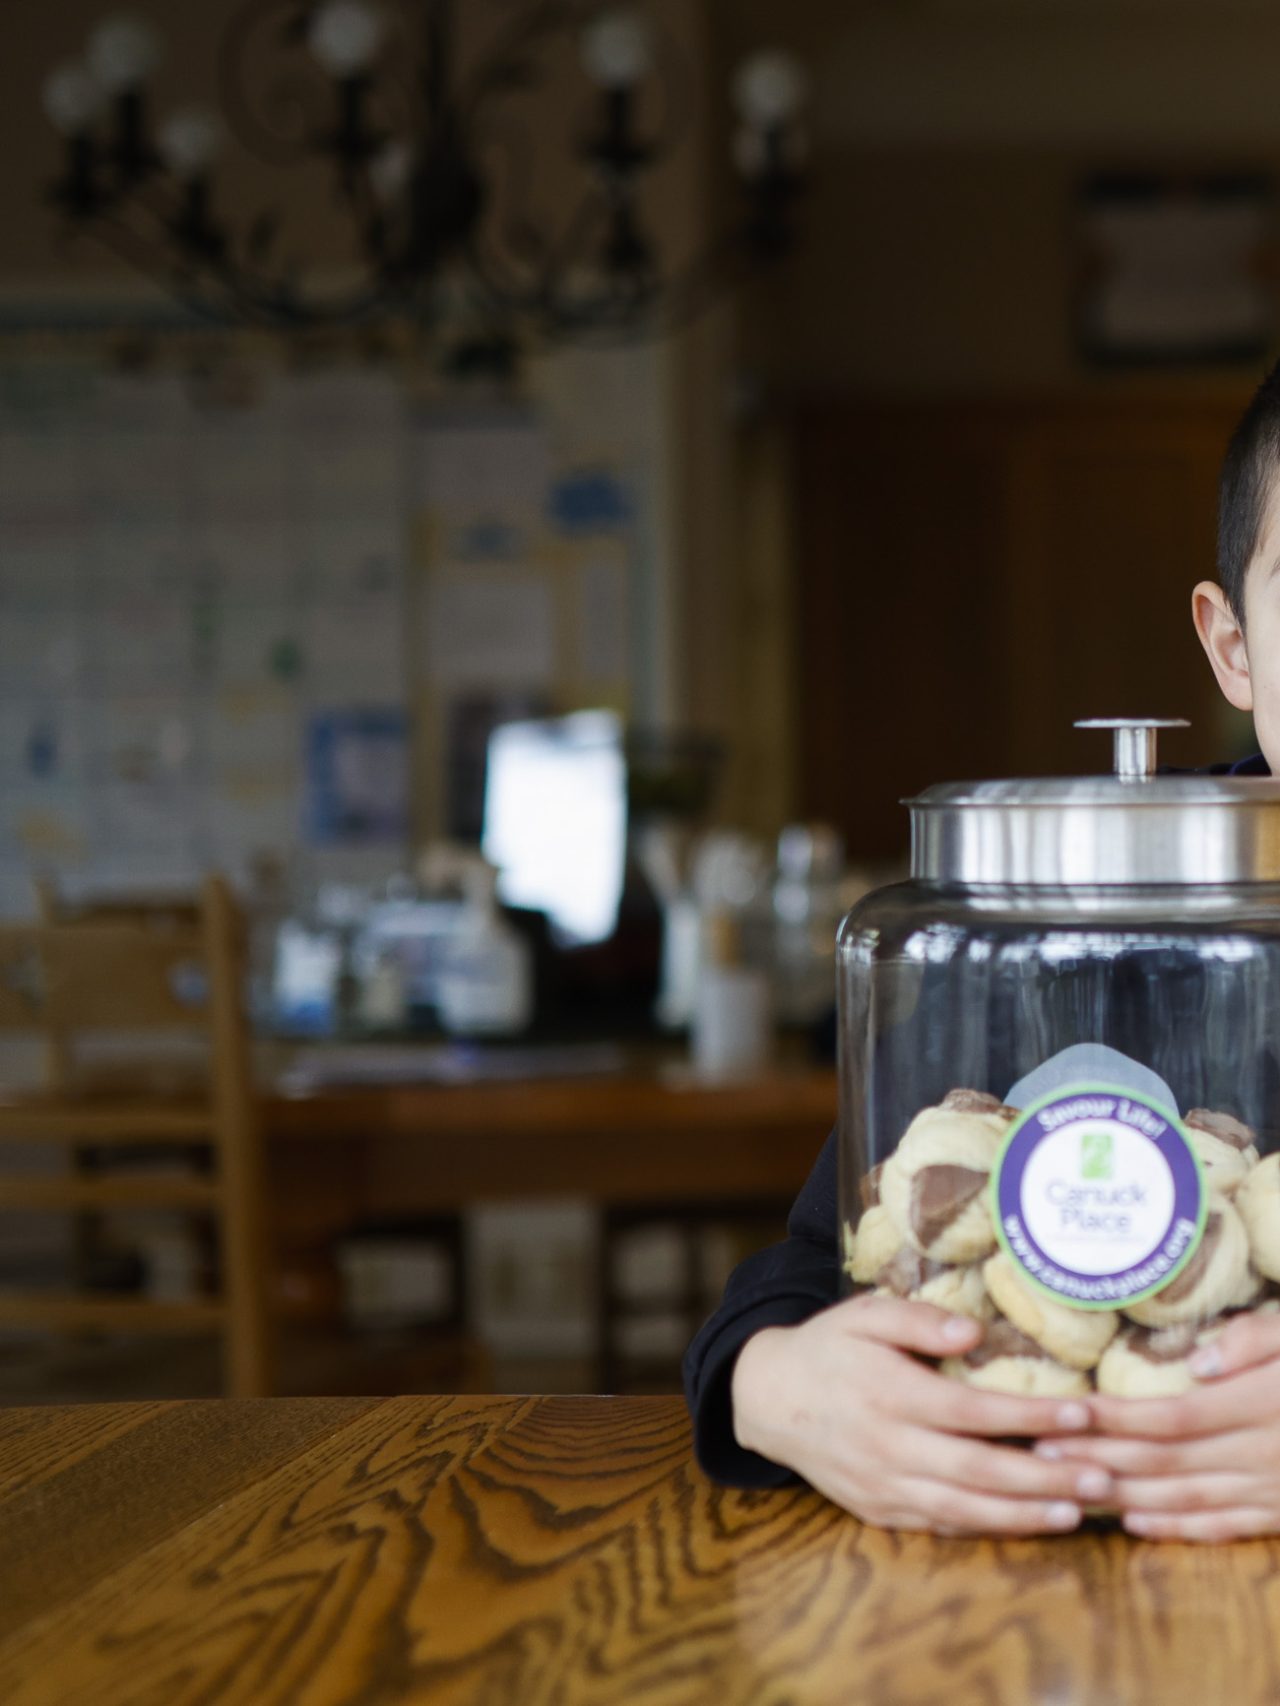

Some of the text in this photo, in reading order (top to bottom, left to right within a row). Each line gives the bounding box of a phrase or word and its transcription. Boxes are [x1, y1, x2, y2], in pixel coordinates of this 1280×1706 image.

[1037, 1098, 1116, 1132] Savour
[1046, 1179, 1145, 1206] Canuck
[1061, 1206, 1131, 1232] Place
